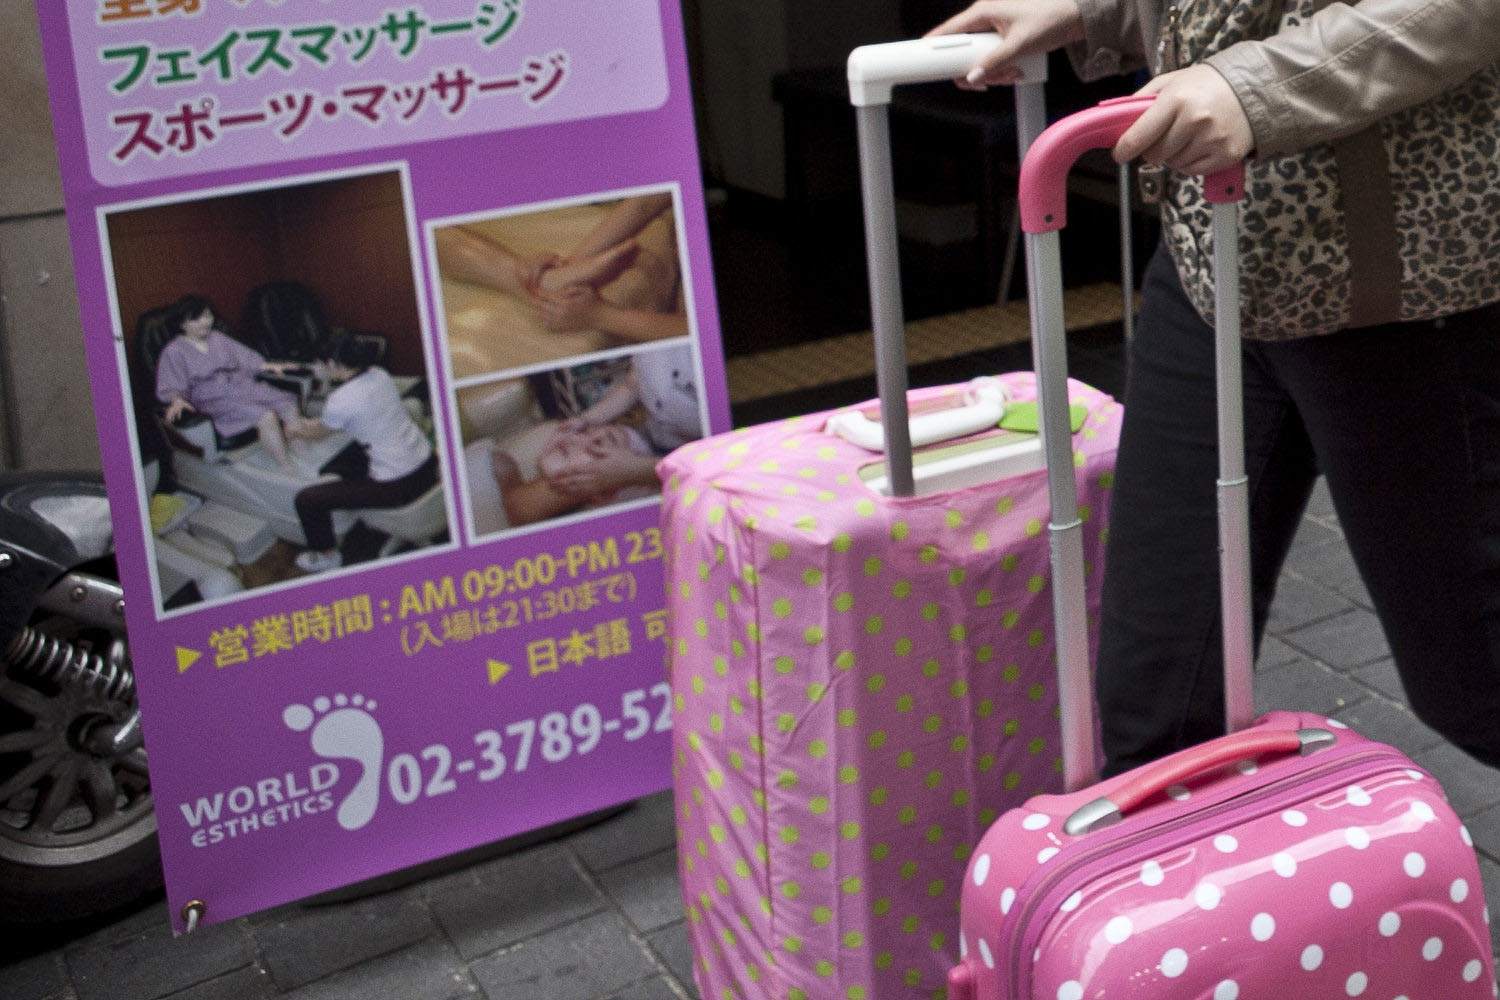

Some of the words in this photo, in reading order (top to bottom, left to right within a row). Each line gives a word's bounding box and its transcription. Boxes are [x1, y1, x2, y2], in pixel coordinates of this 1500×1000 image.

[399, 578, 457, 617] AM
[527, 616, 631, 679] 日本語
[180, 763, 340, 828] WORLD
